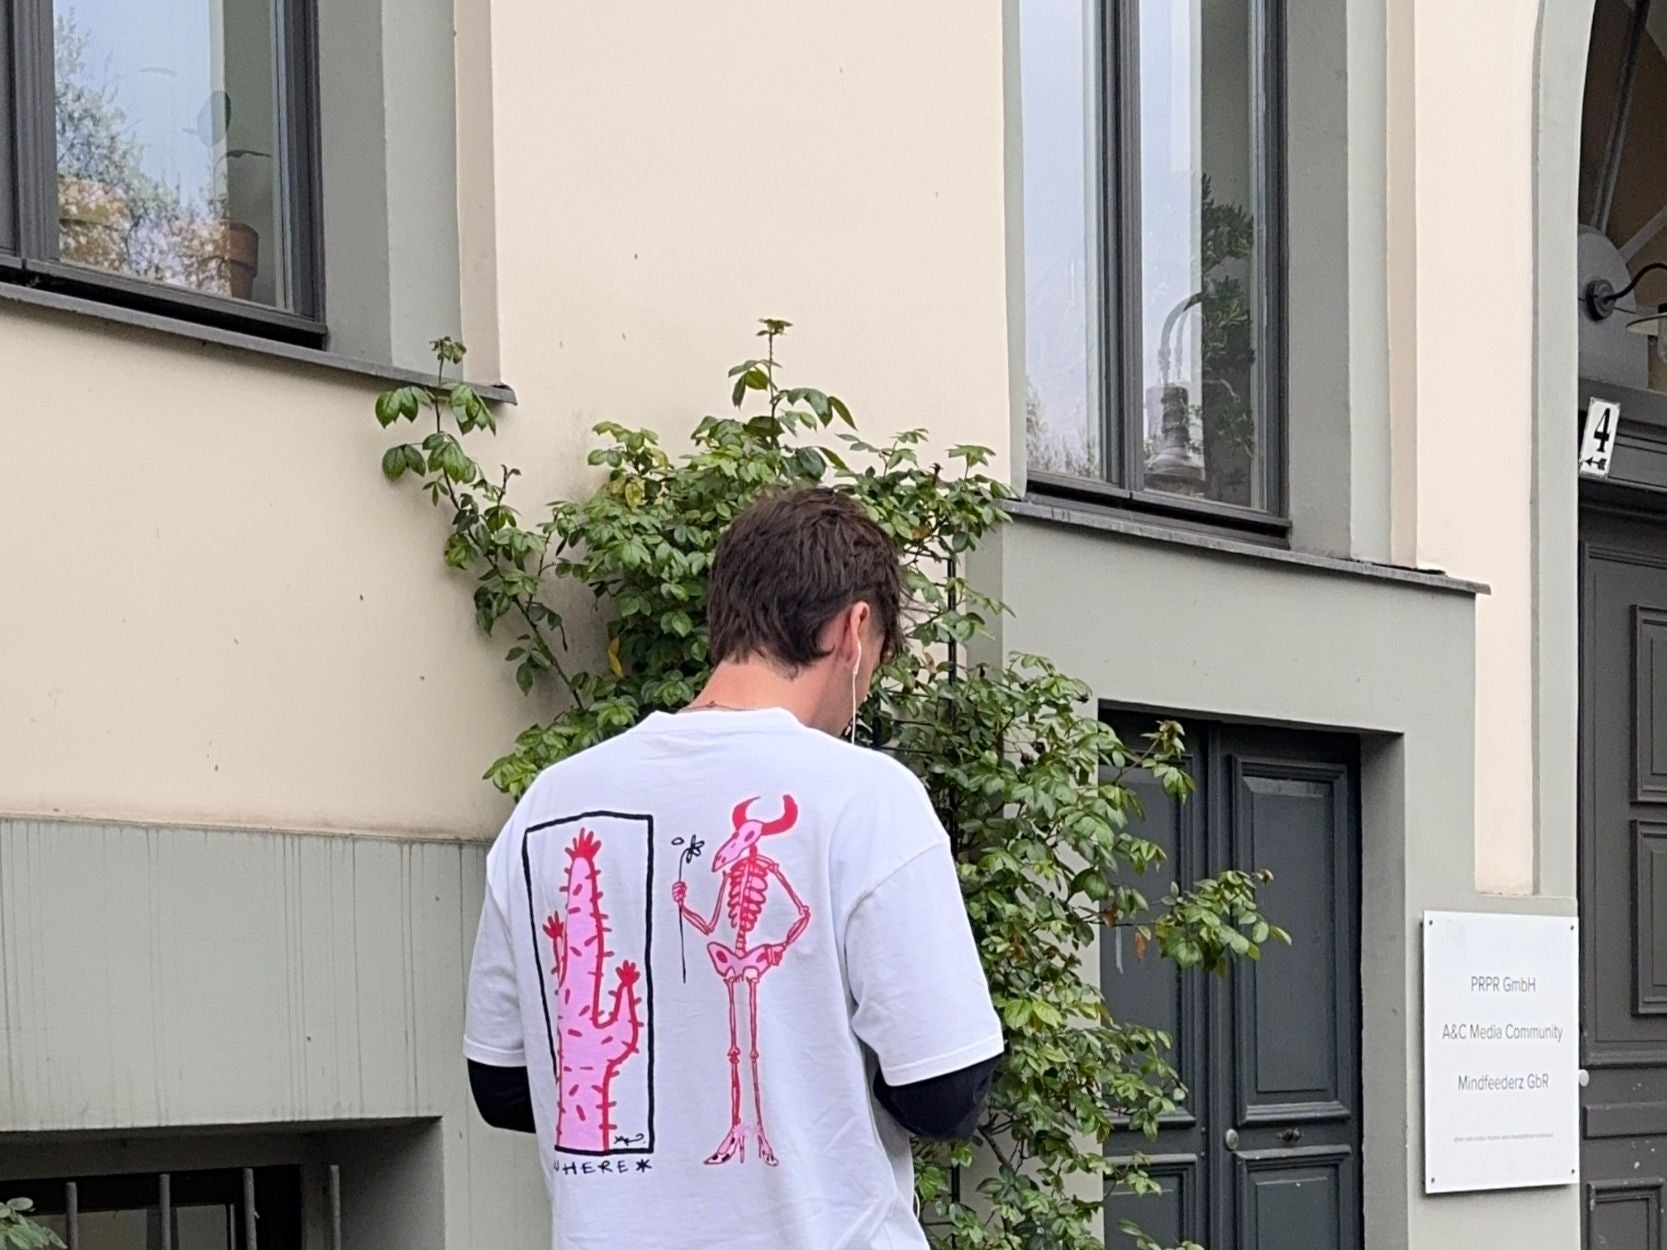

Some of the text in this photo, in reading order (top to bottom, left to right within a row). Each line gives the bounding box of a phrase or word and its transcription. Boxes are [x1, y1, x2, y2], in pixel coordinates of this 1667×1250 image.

[1594, 407, 1611, 453] 4
[1471, 975, 1537, 993] PRPR GmbH
[1442, 1023, 1564, 1043] A&C Media Community
[1458, 1073, 1550, 1091] Mindfeederz GbR
